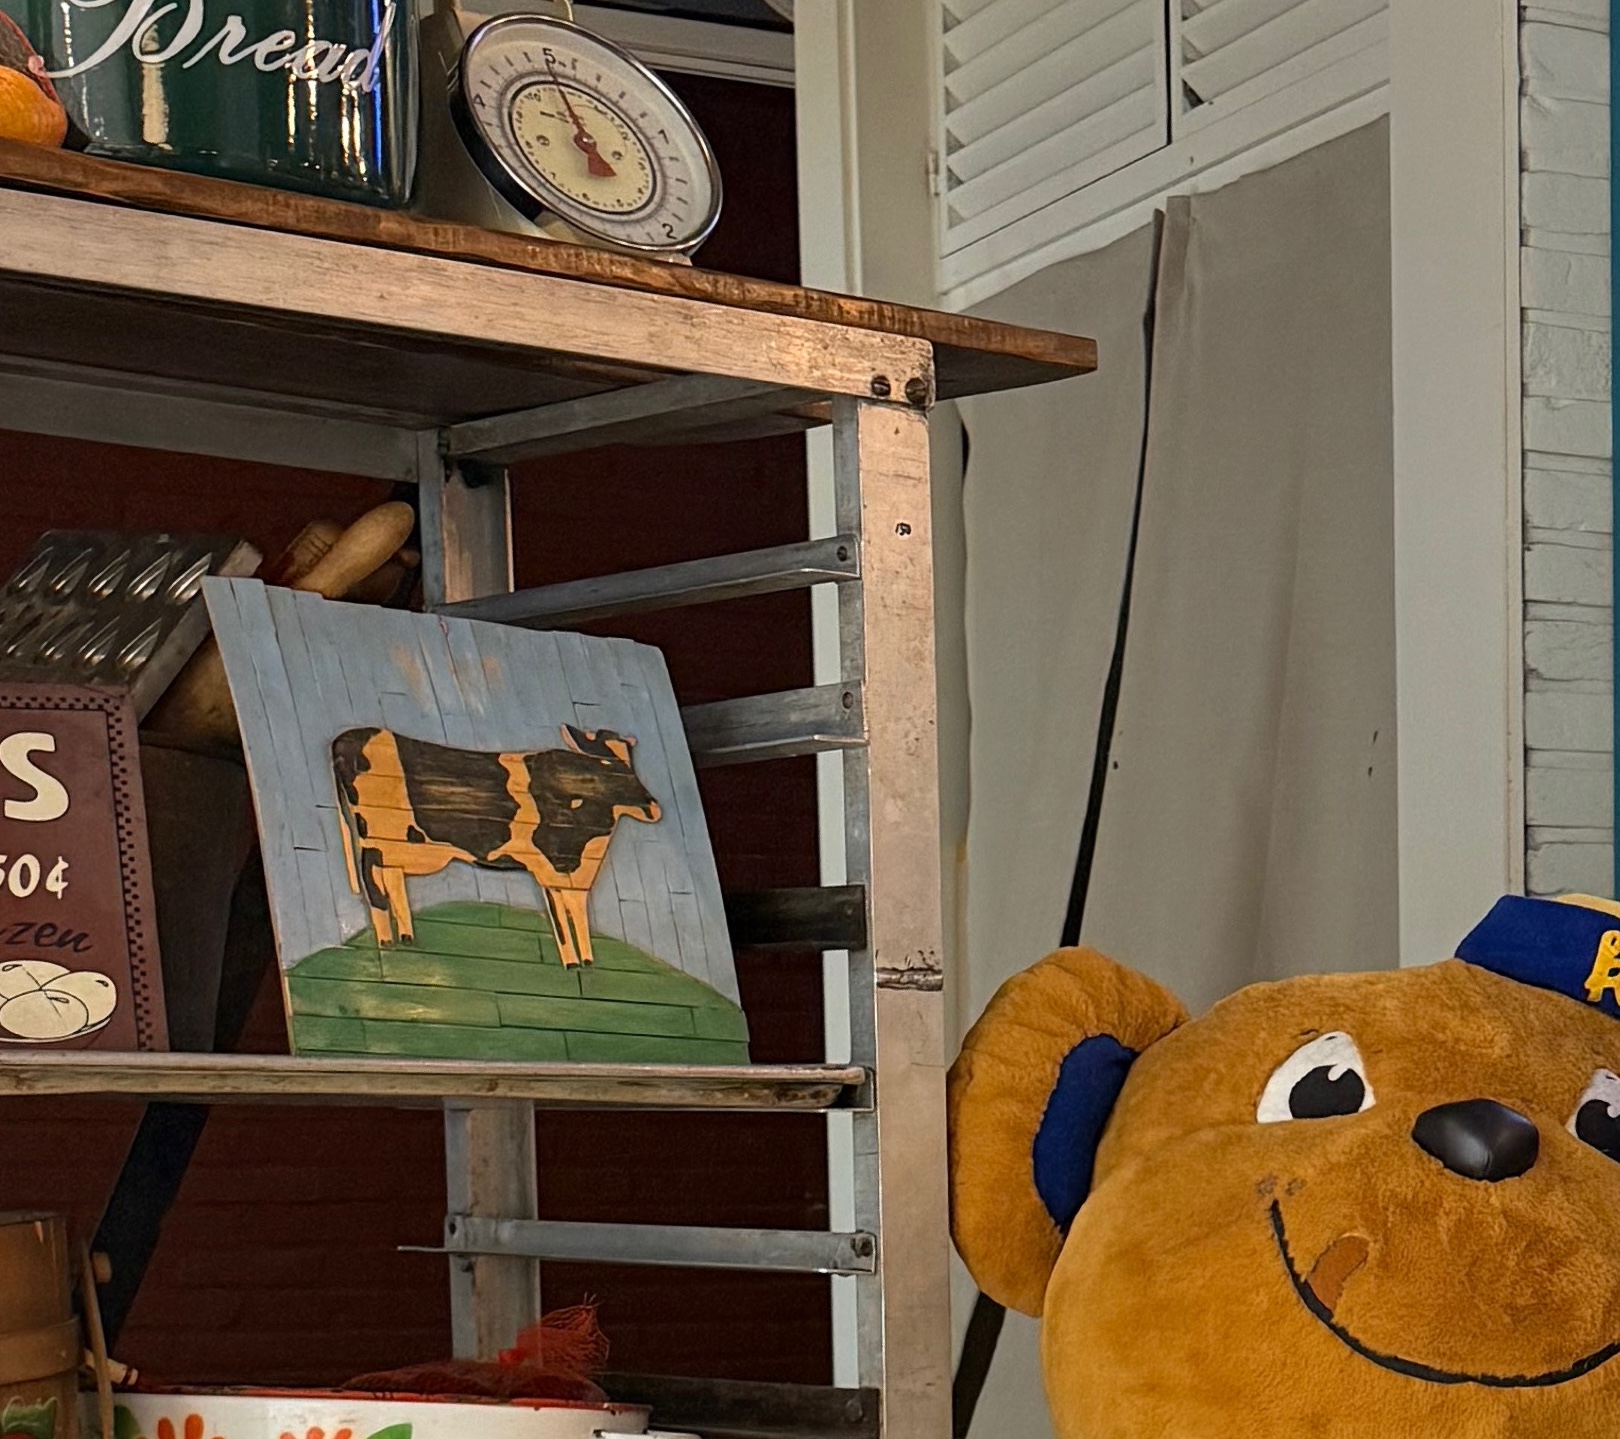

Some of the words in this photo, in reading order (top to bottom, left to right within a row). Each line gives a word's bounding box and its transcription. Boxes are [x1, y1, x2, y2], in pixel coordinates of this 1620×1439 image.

[46, 0, 397, 93] Bread
[0, 853, 70, 900] 0¢
[0, 922, 94, 953] zen
